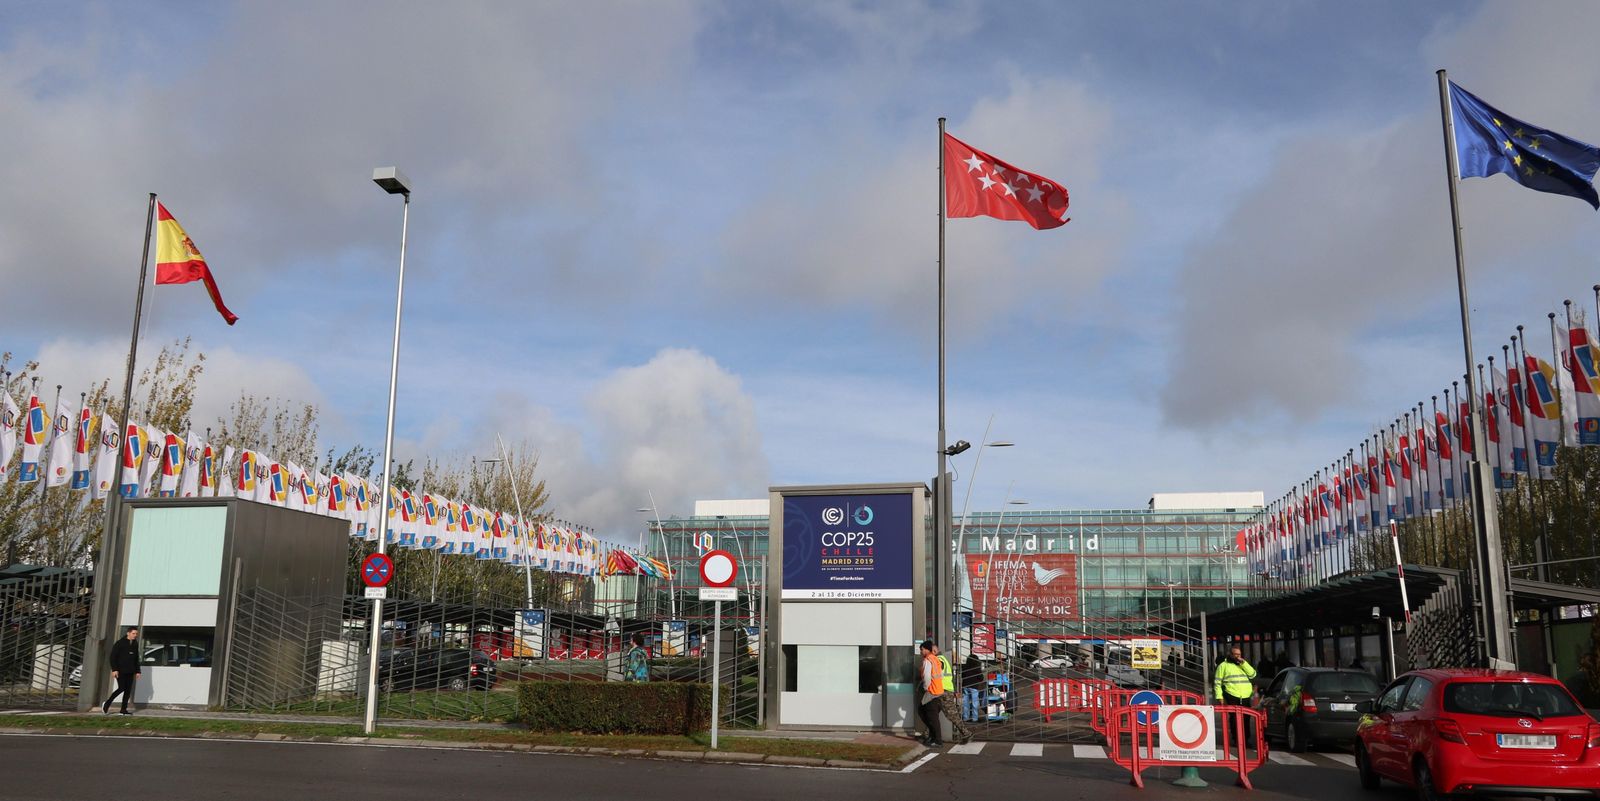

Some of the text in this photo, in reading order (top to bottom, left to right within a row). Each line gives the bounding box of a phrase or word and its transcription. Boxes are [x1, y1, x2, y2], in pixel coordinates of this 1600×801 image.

[821, 532, 874, 546] COP25
[982, 534, 1099, 551] Madrid
[994, 561, 1027, 569] IFEMA
[1038, 596, 1072, 605] MUNDO
[1012, 605, 1035, 615] NOV
[1053, 605, 1072, 615] DIC
